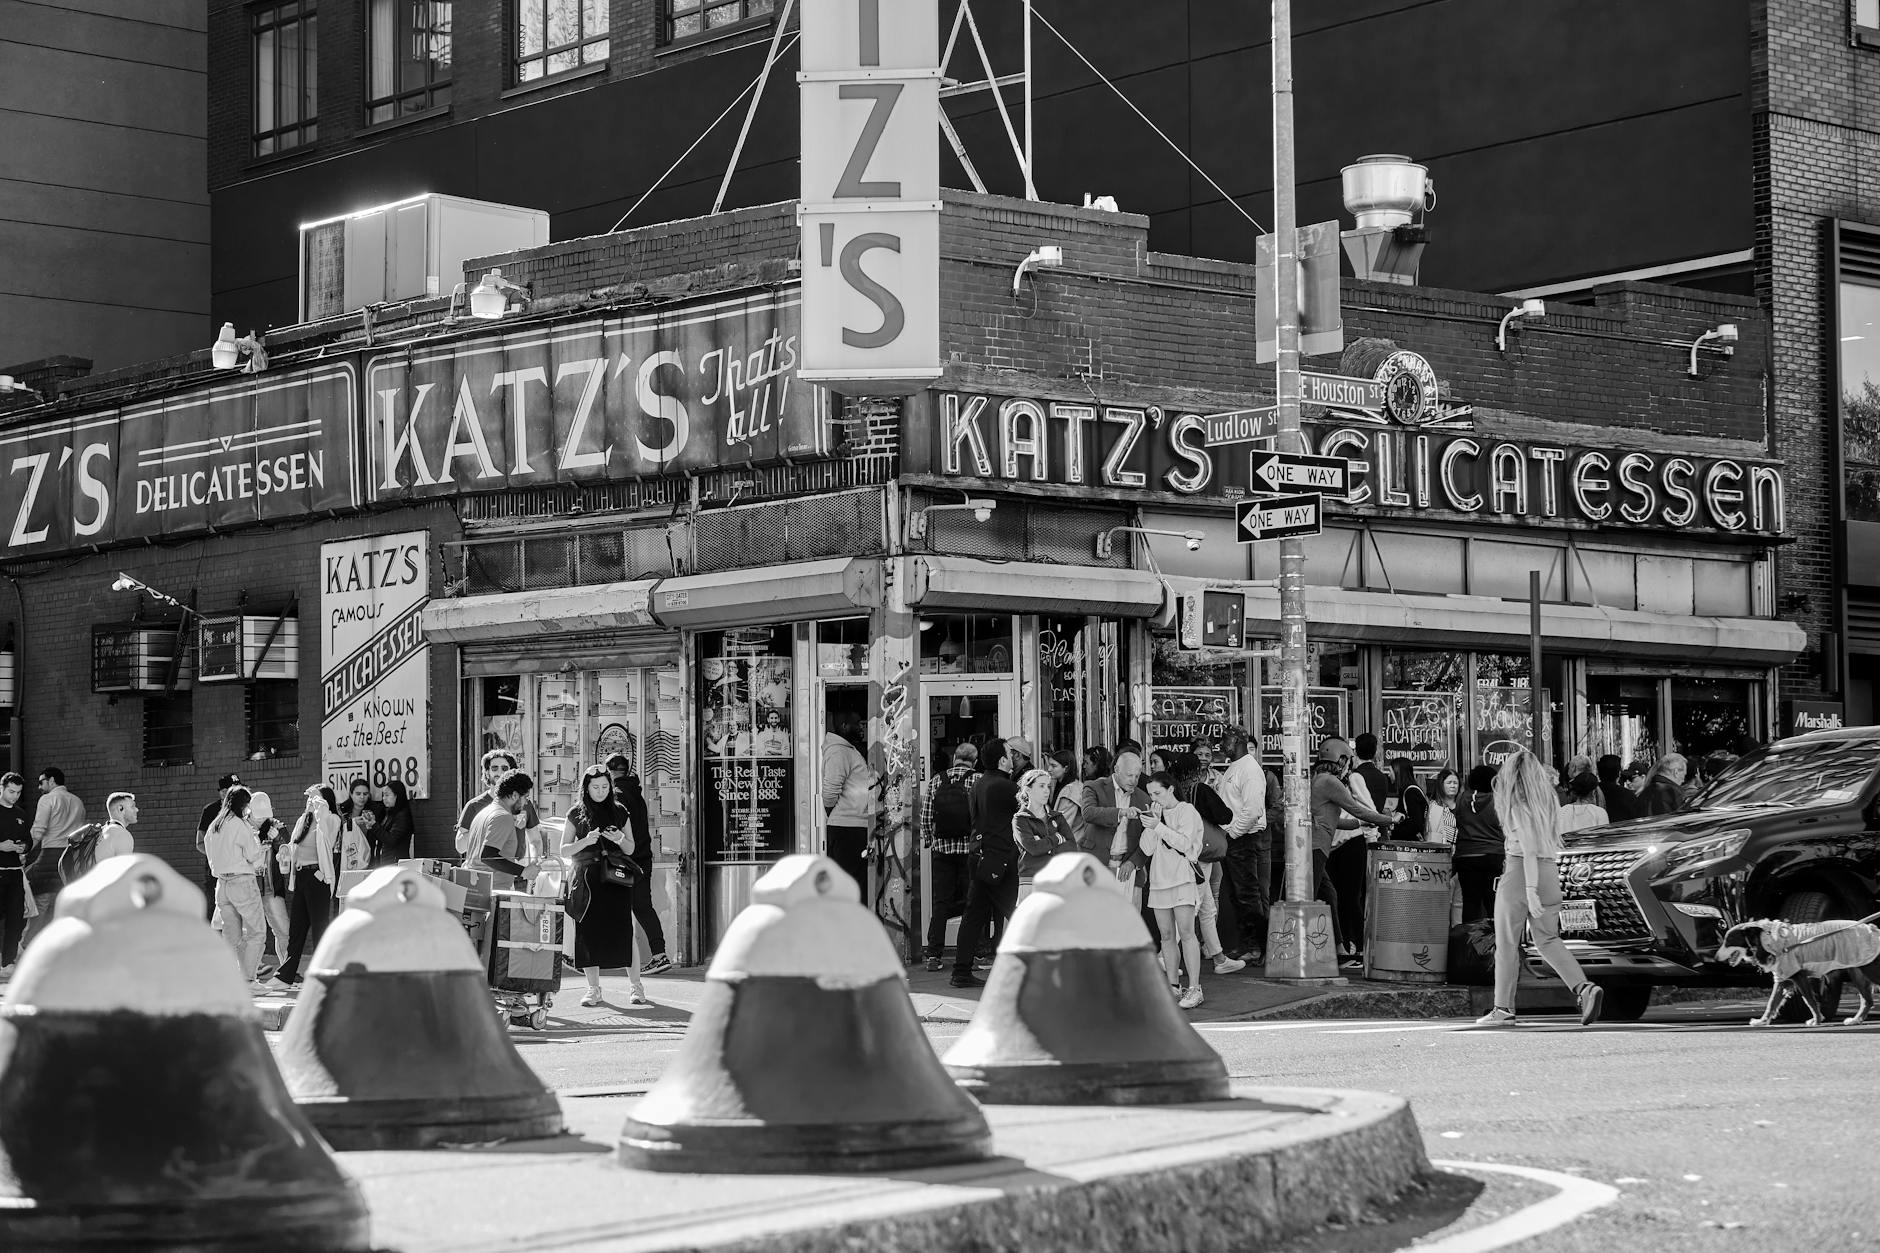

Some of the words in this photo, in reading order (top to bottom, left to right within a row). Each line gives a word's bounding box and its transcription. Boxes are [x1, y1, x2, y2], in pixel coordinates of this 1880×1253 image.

[1301, 375, 1307, 398] E
[1312, 379, 1365, 405] Houston
[1369, 383, 1379, 399] St
[377, 348, 690, 490] KATZ'S
[1206, 416, 1263, 443] Ludlow
[1267, 410, 1278, 426] St
[943, 393, 1214, 494] KATZ'S
[135, 450, 324, 514] DELICATESSEN
[1266, 464, 1294, 482] ONE
[1307, 467, 1336, 485] WAY
[1249, 512, 1273, 529] ONE
[1284, 507, 1310, 525] WAY
[325, 544, 419, 594] KATZ'S
[324, 610, 422, 716] DELICATESSEN
[363, 697, 414, 719] KNOWN
[1386, 702, 1440, 734] ATZ'S
[1795, 711, 1843, 729] Marshalls
[336, 734, 350, 749] as
[353, 722, 372, 748] the
[373, 719, 407, 747] Best
[711, 766, 732, 779] The
[734, 766, 759, 778] Real
[760, 765, 786, 778] Taste
[1488, 752, 1510, 765] THAT
[714, 777, 728, 790] of
[727, 777, 755, 790] New
[756, 776, 783, 789] York.
[718, 789, 750, 801] Since
[751, 788, 781, 800] 1888.
